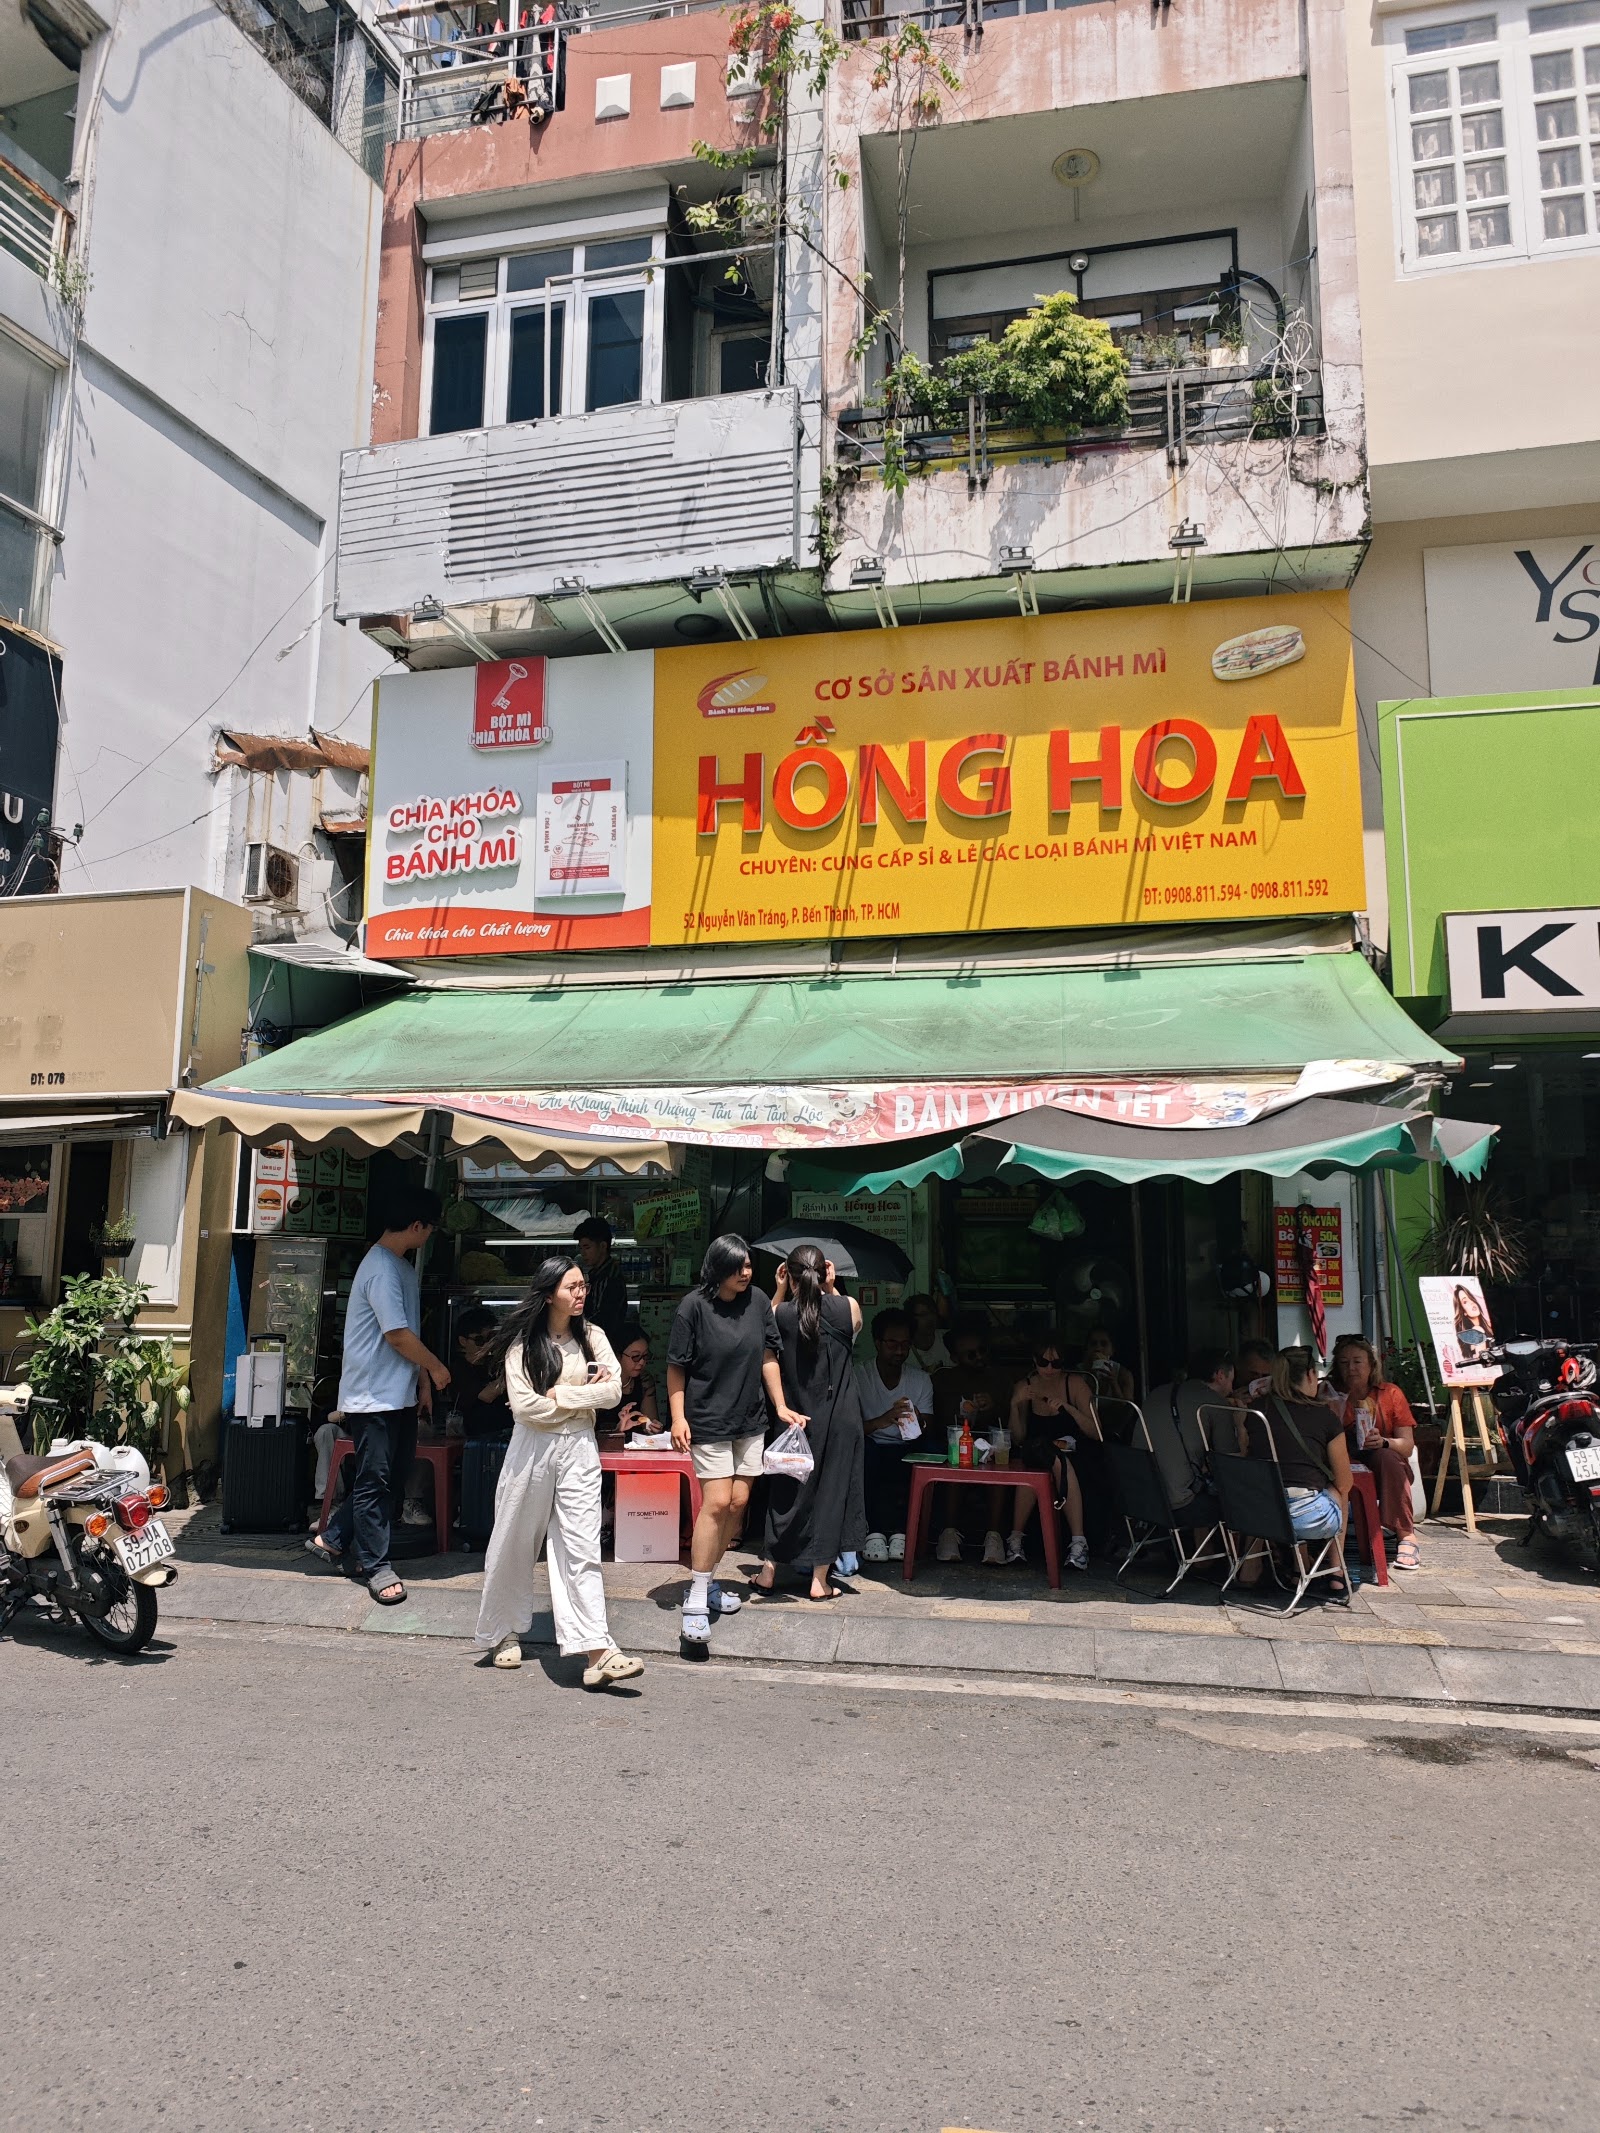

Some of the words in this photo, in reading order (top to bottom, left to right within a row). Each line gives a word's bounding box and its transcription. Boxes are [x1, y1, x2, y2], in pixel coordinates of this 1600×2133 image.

[814, 676, 853, 701] CƠ
[858, 667, 896, 698] SỞ
[901, 664, 957, 694] SẢN
[964, 656, 1037, 689] XUẤT
[1043, 654, 1125, 683] BÁNH
[1132, 647, 1167, 676] MÌ
[491, 712, 514, 731] BỘT
[516, 711, 532, 727] MÌ
[468, 729, 496, 745] CHÌA
[499, 727, 531, 743] KHÓA
[698, 715, 1012, 836] HỒNG
[1050, 714, 1306, 814] HOA
[390, 798, 444, 828] CHÌA
[450, 786, 516, 819] KHÓA
[428, 819, 476, 843] CHO
[387, 843, 471, 879] BÁNH
[479, 829, 516, 866] MÌ
[739, 856, 817, 876] CHUYÊN:
[821, 854, 874, 872] CUNG
[877, 848, 914, 868] CẤP
[918, 846, 935, 866] SỈ
[939, 849, 953, 865] &
[957, 843, 978, 863] LẺ
[982, 841, 1020, 862] CÁC
[1025, 842, 1068, 862] LOẠI
[1073, 837, 1128, 857] BÁNH
[1134, 833, 1157, 853] MÌ
[1161, 832, 1205, 854] VIỆT
[1210, 830, 1257, 849] NAM
[1144, 887, 1162, 905] ĐT:
[1164, 884, 1241, 904] 0908.811.594
[1251, 879, 1329, 900] 0908.811.592
[684, 912, 695, 929] 52
[698, 908, 735, 932] Nguyễn
[737, 909, 756, 926] Văn
[758, 908, 789, 929] Tráng,
[791, 907, 800, 924] P.
[802, 904, 822, 923] Bến
[824, 904, 858, 924] Thành,
[861, 903, 875, 920] TP.
[878, 902, 900, 920] HCM
[385, 928, 413, 942] Chìa
[417, 926, 449, 940] khóa
[452, 924, 475, 938] cho
[480, 921, 511, 937] Chất
[514, 922, 552, 937] lượng
[538, 1093, 563, 1109] An
[567, 1095, 611, 1119] Khang
[614, 1096, 649, 1118] Thịnh
[653, 1099, 698, 1125] Vượng
[709, 1101, 732, 1120] Tấn
[738, 1102, 758, 1121] Tài
[764, 1103, 788, 1122] Tấn
[793, 1103, 824, 1124] Lộc
[588, 1124, 657, 1140] HAPPY
[657, 1129, 705, 1145] NEW
[709, 1132, 764, 1147] YEAR
[803, 1202, 827, 1213] Bánh
[844, 1198, 875, 1214] Hồng
[877, 1200, 901, 1212] Hoa
[1278, 1211, 1289, 1226] BÒ
[1278, 1228, 1295, 1241] Bò
[1576, 1463, 1600, 1478] 454
[123, 1525, 161, 1552] 59-UA
[126, 1539, 171, 1570] 027.08
